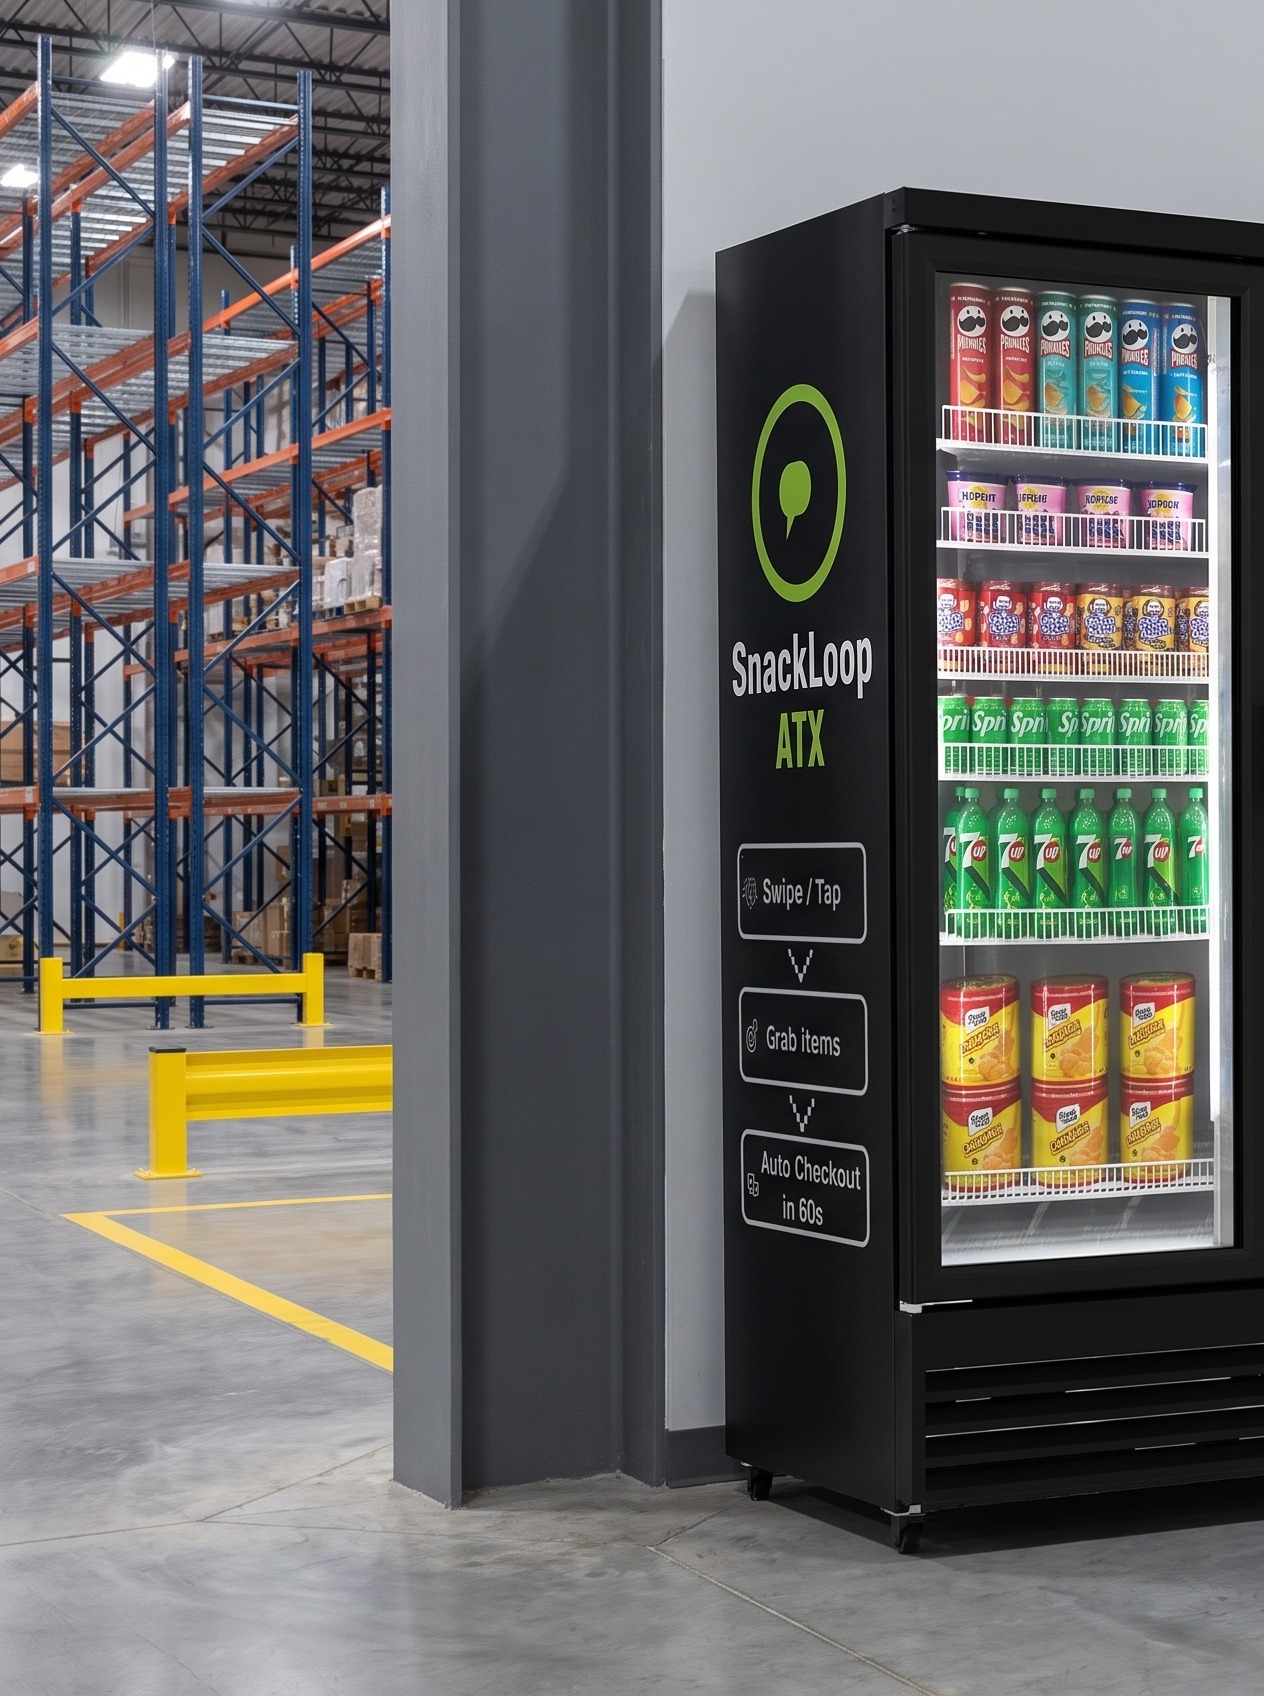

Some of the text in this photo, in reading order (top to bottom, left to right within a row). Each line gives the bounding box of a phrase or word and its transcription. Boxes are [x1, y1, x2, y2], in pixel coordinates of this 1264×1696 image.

[732, 631, 873, 699] SnackLoop
[775, 709, 825, 769] ATX
[762, 878, 841, 911] Swipe / Tap
[766, 1025, 840, 1056] Grab items
[761, 1151, 861, 1190] Auto Checkout
[782, 1194, 823, 1226] in 60s
